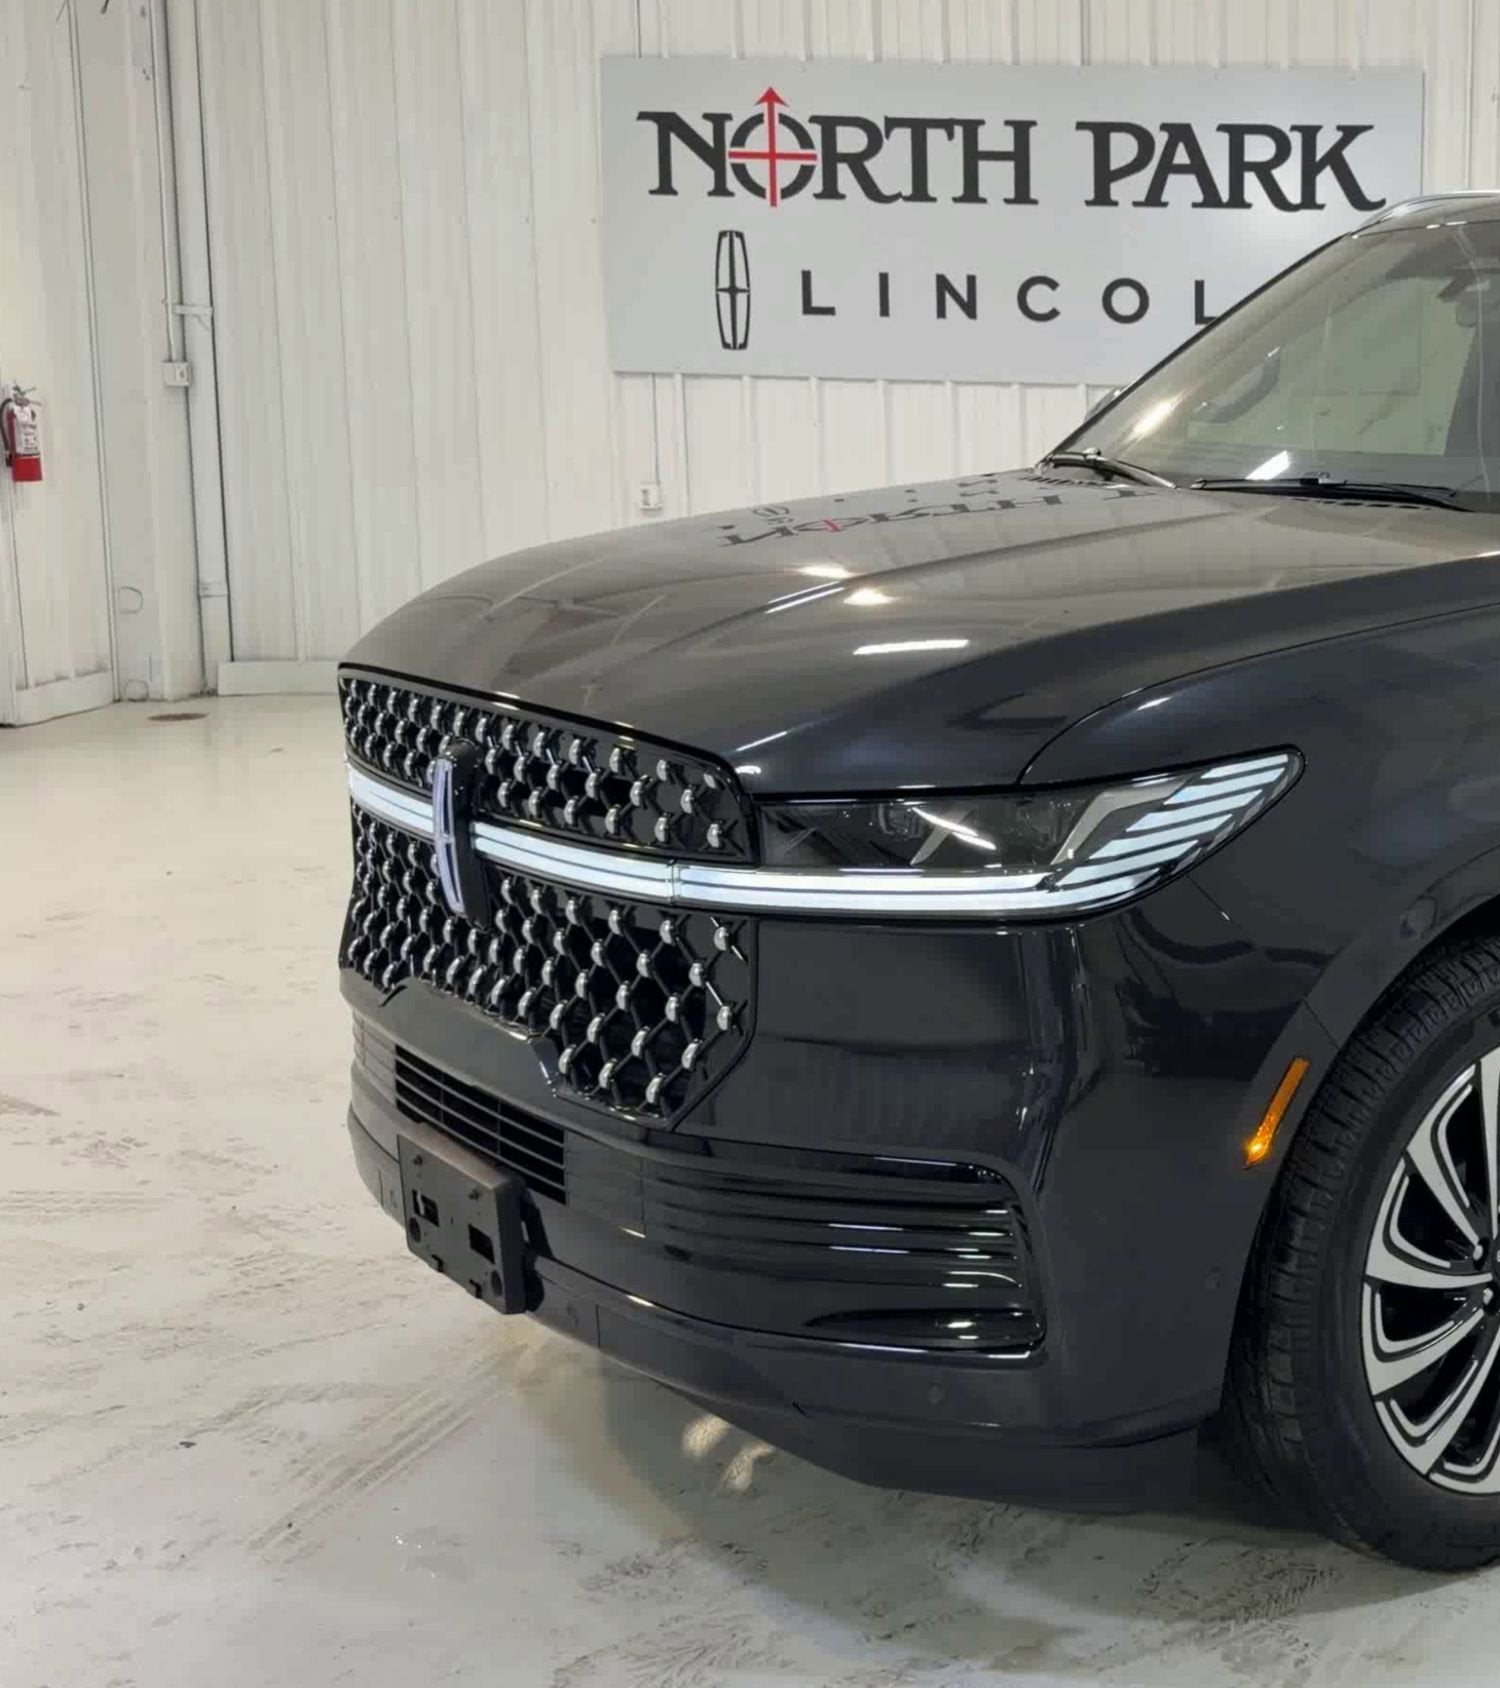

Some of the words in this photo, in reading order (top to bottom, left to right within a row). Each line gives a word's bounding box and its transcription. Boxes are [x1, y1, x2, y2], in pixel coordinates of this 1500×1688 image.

[637, 110, 1040, 206] NORTH
[1074, 121, 1387, 212] PARK
[801, 269, 1218, 326] LINCOL
